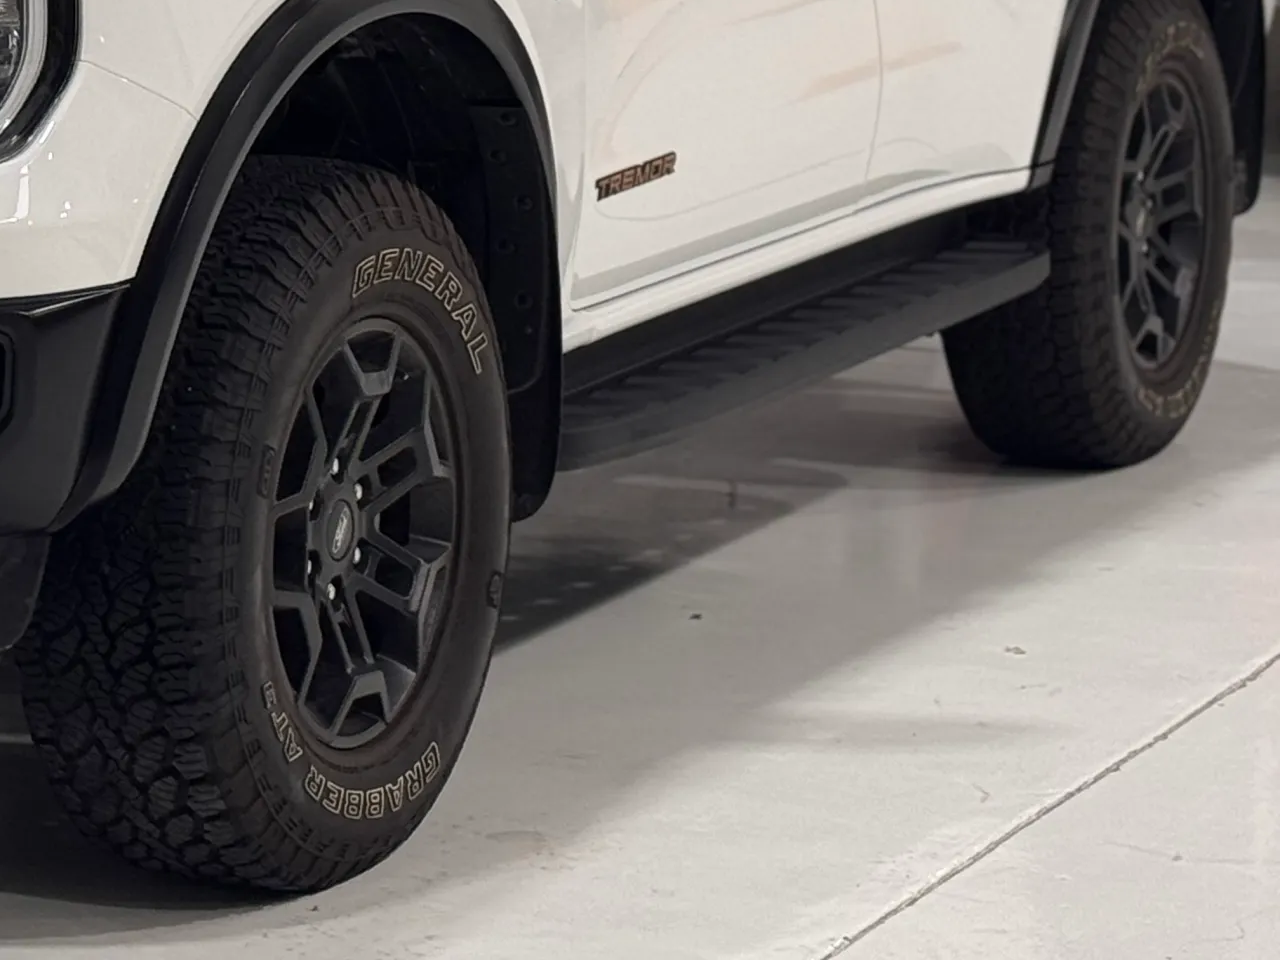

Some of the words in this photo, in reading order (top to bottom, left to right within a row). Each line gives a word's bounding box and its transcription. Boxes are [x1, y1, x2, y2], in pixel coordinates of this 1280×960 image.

[595, 151, 676, 201] TREMOR
[352, 248, 488, 374] GENERAL
[304, 742, 440, 819] GRABBER
